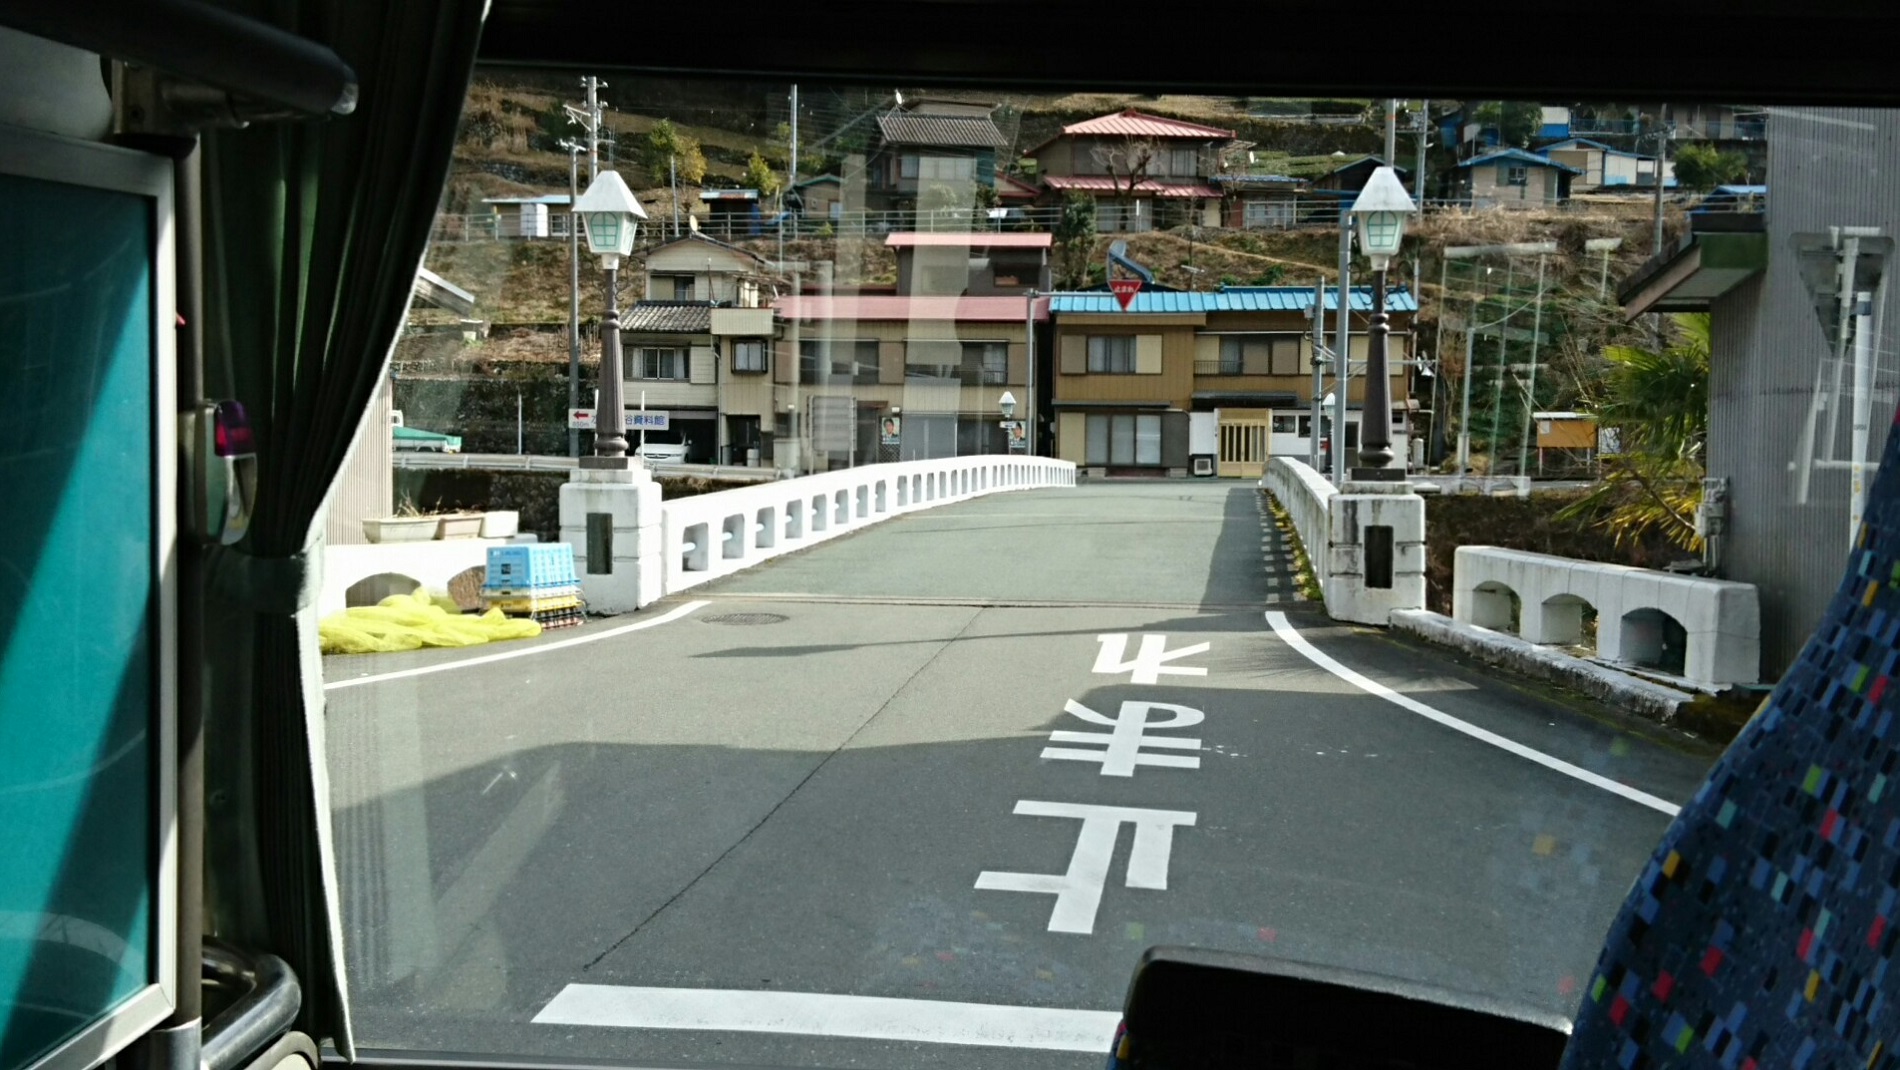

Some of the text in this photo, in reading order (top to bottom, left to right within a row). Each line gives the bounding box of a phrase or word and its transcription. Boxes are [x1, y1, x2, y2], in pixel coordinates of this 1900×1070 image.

[1114, 285, 1135, 293] 止まれ
[973, 632, 1210, 935] 止まれ
